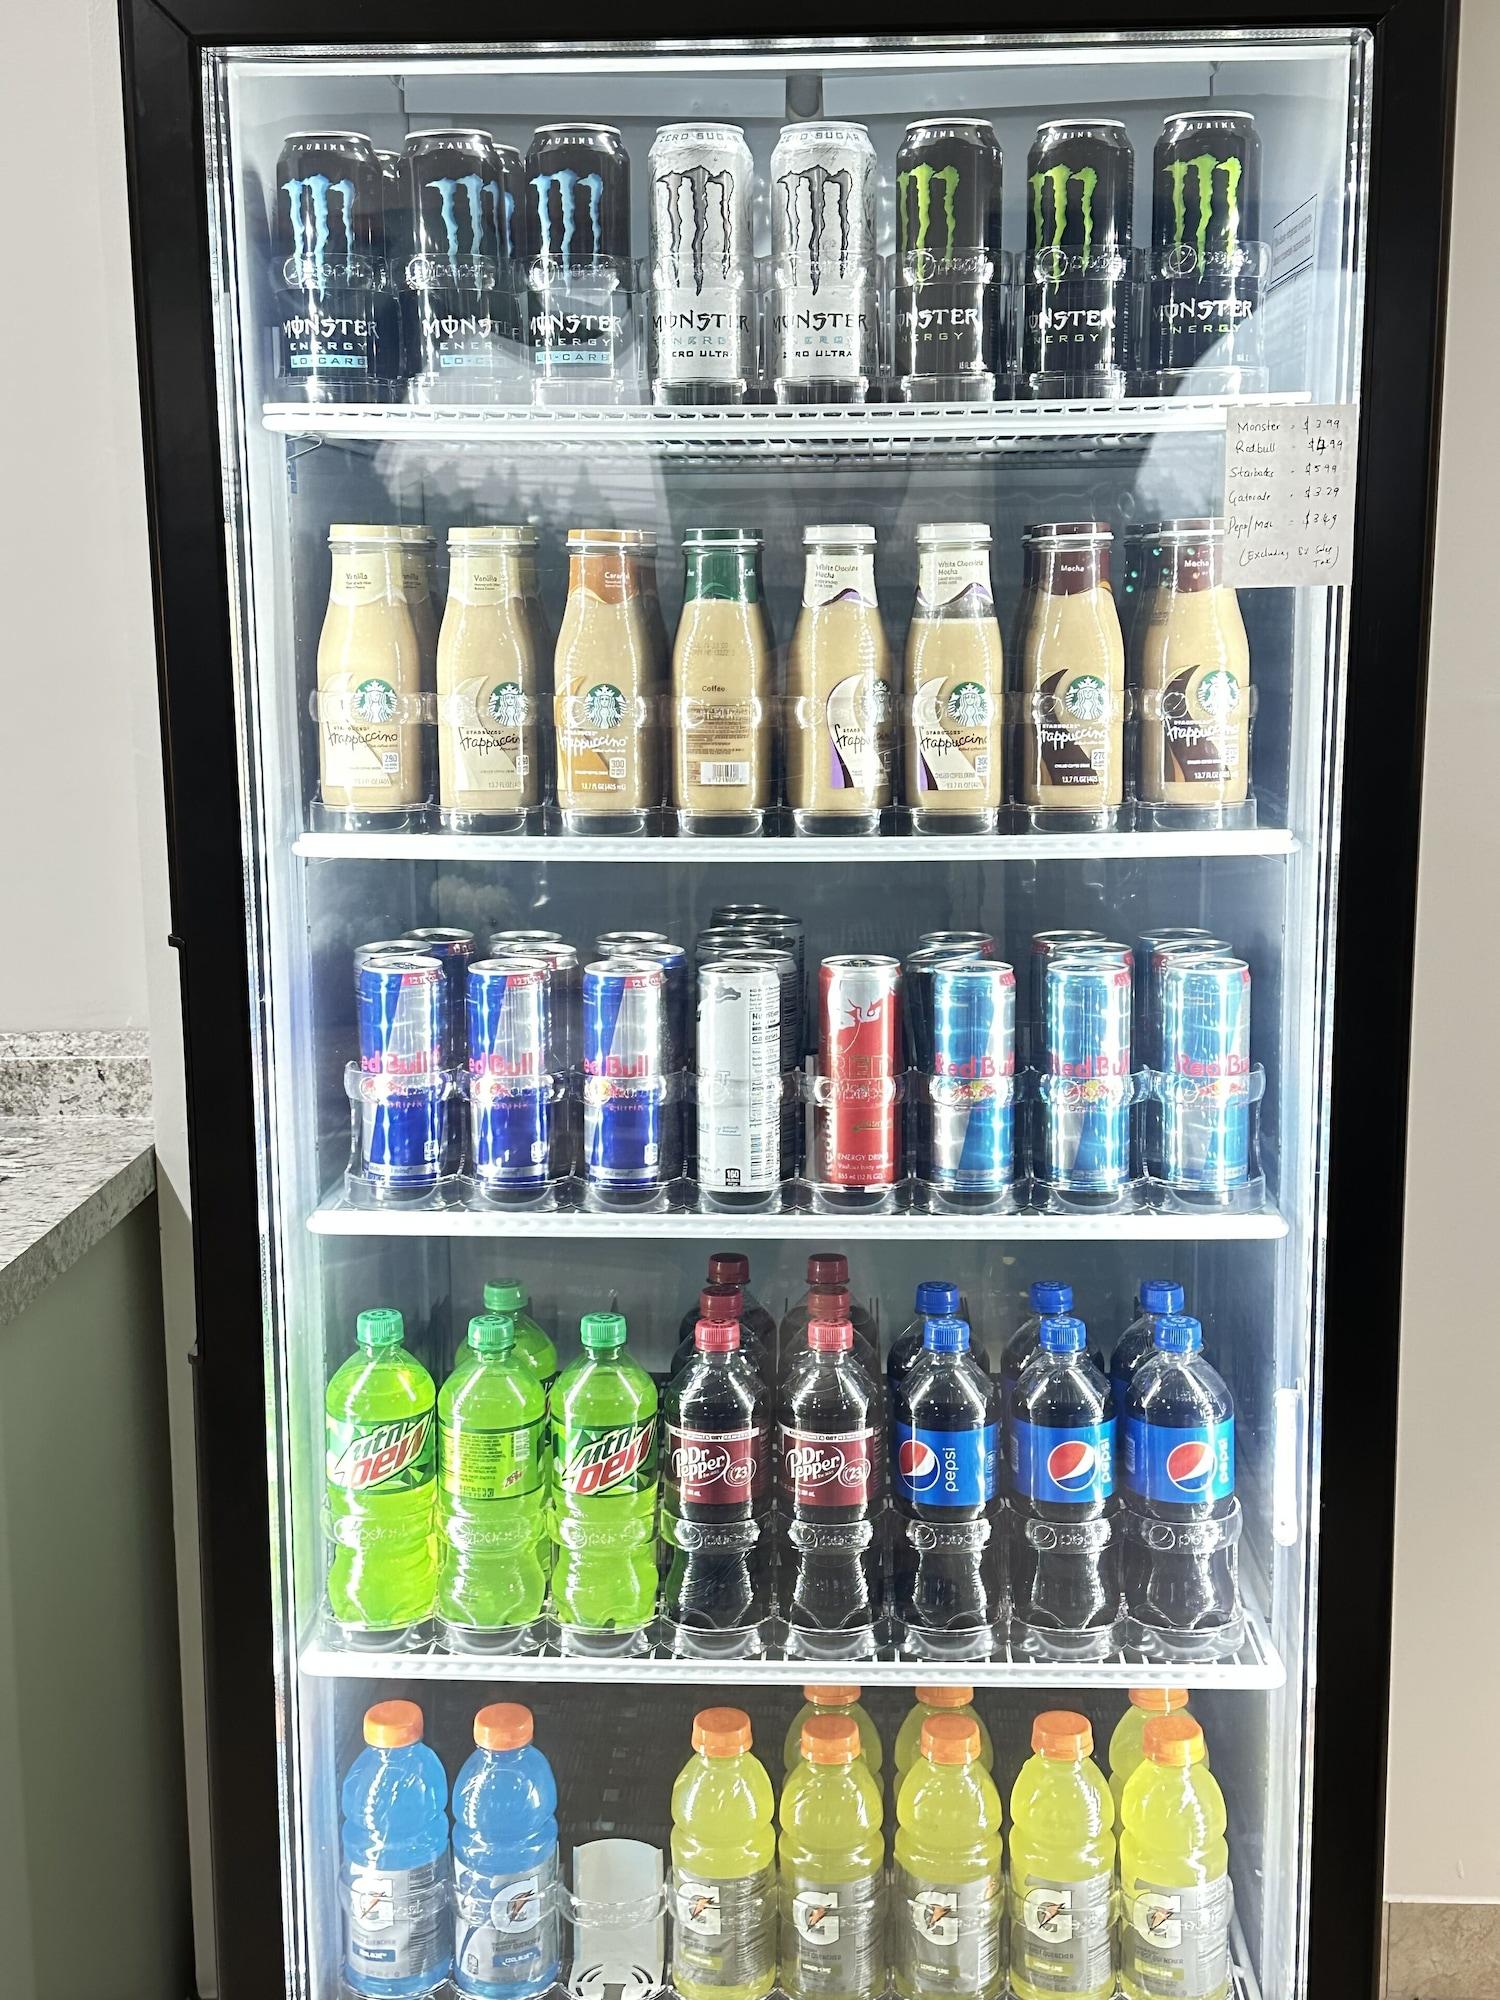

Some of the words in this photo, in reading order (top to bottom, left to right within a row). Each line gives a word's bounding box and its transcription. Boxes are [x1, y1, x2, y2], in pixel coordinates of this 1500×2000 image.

[1152, 298, 1254, 321] MONSTER
[283, 315, 379, 340] MONSTER
[530, 312, 624, 337] MONSTER
[652, 309, 750, 333] MONSTER
[773, 309, 868, 333] MONSTER
[1160, 324, 1243, 337] ENERGY
[290, 341, 368, 351] ENERGY
[535, 338, 611, 347] ENERGY
[1238, 420, 1281, 434] Monster
[1060, 564, 1085, 573] Mocha
[1184, 559, 1210, 568] Mocha
[473, 574, 498, 582] Vanilla
[386, 1051, 428, 1075] Bull
[489, 1052, 533, 1076] Bull
[605, 1055, 649, 1077] Bull
[934, 1052, 977, 1078] Red
[675, 1448, 726, 1481] Pepper
[687, 1446, 710, 1464] Dr
[790, 1449, 841, 1482] Pepper
[801, 1446, 825, 1464] Dr
[1099, 1437, 1113, 1484] pepsi
[734, 1466, 749, 1480] 23
[848, 1466, 864, 1480] 23
[942, 1447, 960, 1492] pepsi
